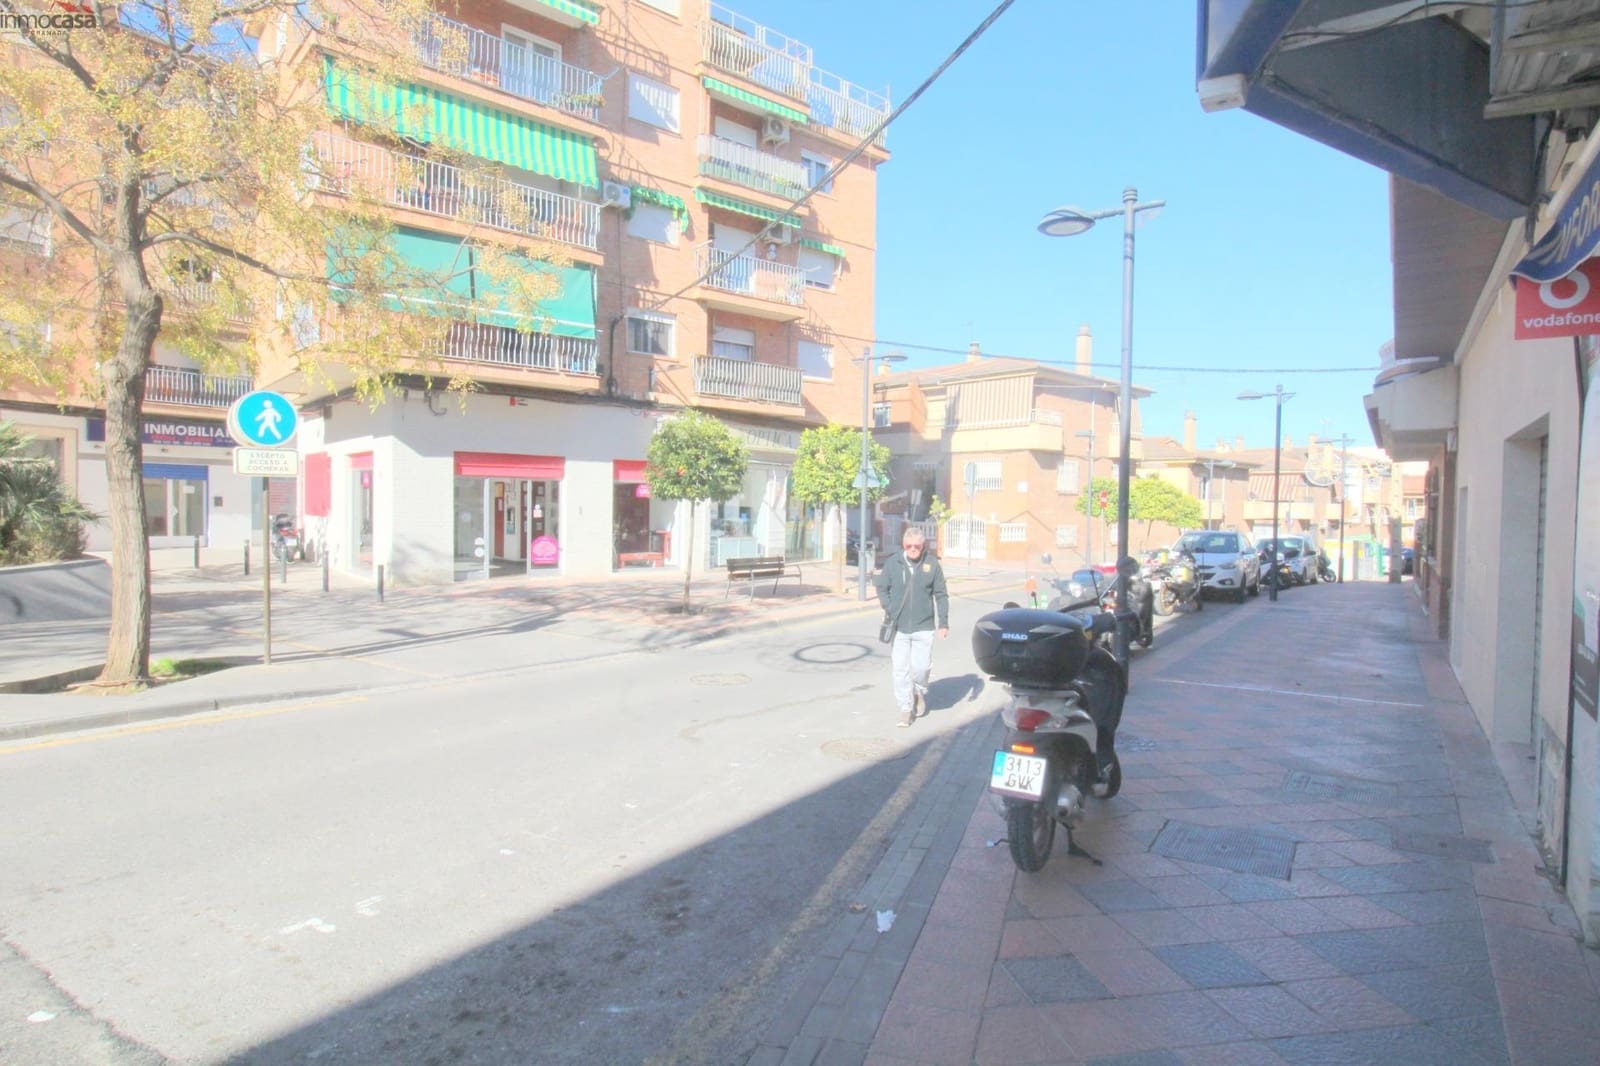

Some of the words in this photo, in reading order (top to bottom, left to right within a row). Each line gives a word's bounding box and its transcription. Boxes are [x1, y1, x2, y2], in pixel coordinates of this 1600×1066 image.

[144, 423, 231, 438] INMOBILIA
[1006, 757, 1042, 776] 3113
[1006, 773, 1035, 791] GVK
